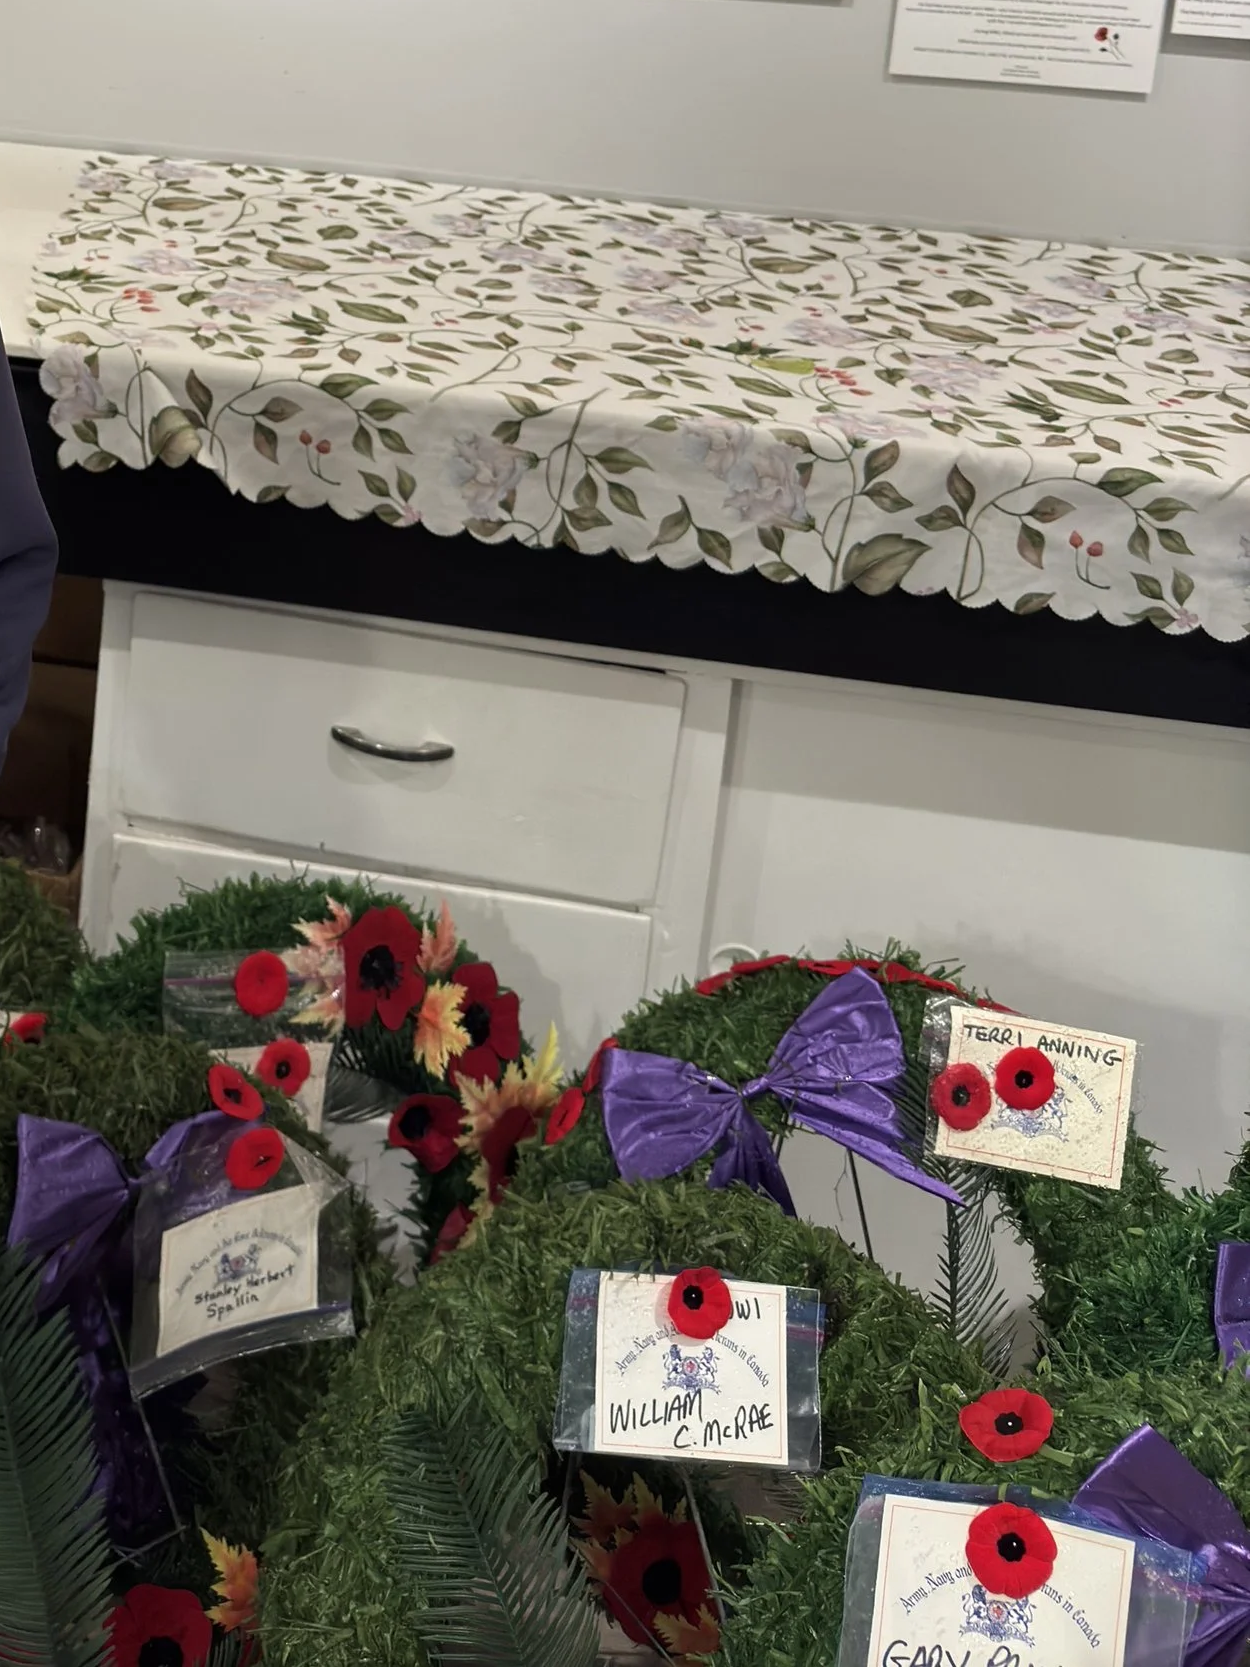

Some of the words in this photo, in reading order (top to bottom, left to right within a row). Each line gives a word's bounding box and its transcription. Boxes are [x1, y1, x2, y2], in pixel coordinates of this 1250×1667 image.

[963, 1023, 1023, 1047] TERRI
[1037, 1034, 1123, 1067] ANNING
[194, 1283, 243, 1305] Stanley
[246, 1264, 296, 1286] Herbert
[610, 1389, 703, 1435] WILLIAM
[673, 1424, 698, 1449] C.
[703, 1403, 775, 1448] McRAE
[925, 1571, 955, 1592] Navy
[1063, 1596, 1075, 1614] in
